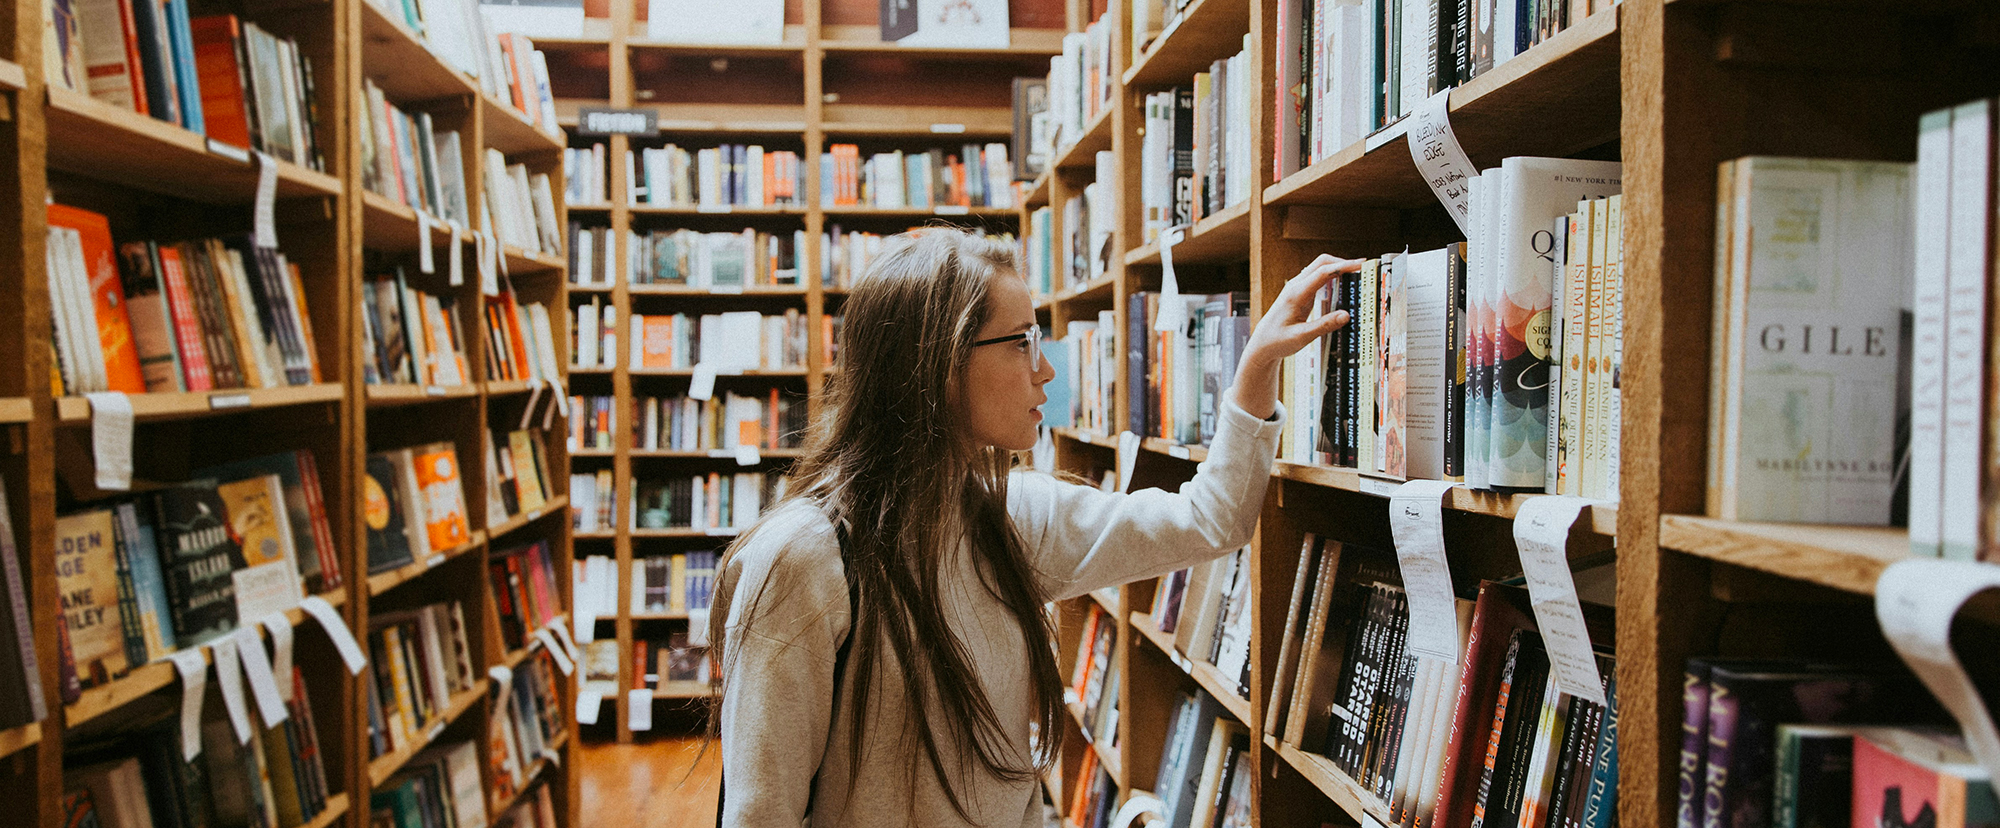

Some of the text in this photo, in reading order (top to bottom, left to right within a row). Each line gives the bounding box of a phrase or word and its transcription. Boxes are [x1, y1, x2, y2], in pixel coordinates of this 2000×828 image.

[1427, 0, 1438, 79] EEDING EDGE
[1456, 0, 1467, 72] EDING EDGE
[588, 112, 647, 132] FICTION
[1423, 142, 1445, 161] EDGE
[1585, 177, 1606, 185] YORK
[1609, 178, 1622, 186] TIM
[1499, 214, 1508, 281] QUINDLEN
[1572, 264, 1585, 340] ISHMAEL
[1589, 265, 1602, 342] ISHMAEL
[1604, 262, 1616, 341] ISHMAEL
[1537, 337, 1551, 347] CO
[1759, 324, 1887, 357] GILE
[1347, 418, 1355, 449] QUICK
[1549, 409, 1557, 462] Quindlen
[1568, 378, 1579, 456] DANIEL QUINN
[1585, 381, 1596, 460] DANIEL QUINN
[1599, 381, 1610, 461] DANIEL QUINN
[56, 530, 101, 556] DEN
[1464, 630, 1478, 668] Devil
[1461, 668, 1467, 680] in
[1601, 674, 1609, 692] THI
[1343, 661, 1363, 736] OTARED
[1350, 665, 1370, 740] OTARED
[1357, 669, 1378, 745] OTARED
[1448, 684, 1467, 745] Jerusalem
[1566, 717, 1578, 753] RAKHA
[1583, 708, 1592, 732] WHY
[1593, 711, 1601, 732] WHY
[1382, 725, 1393, 766] Rachman
[1391, 728, 1402, 770] Rachman
[1577, 738, 1586, 763] CAME
[1586, 743, 1595, 767] CAME
[1431, 755, 1451, 828] NAOMI RAGEN
[1504, 775, 1514, 809] Childhood
[1512, 780, 1522, 814] Childhood
[1550, 793, 1563, 828] CROC
